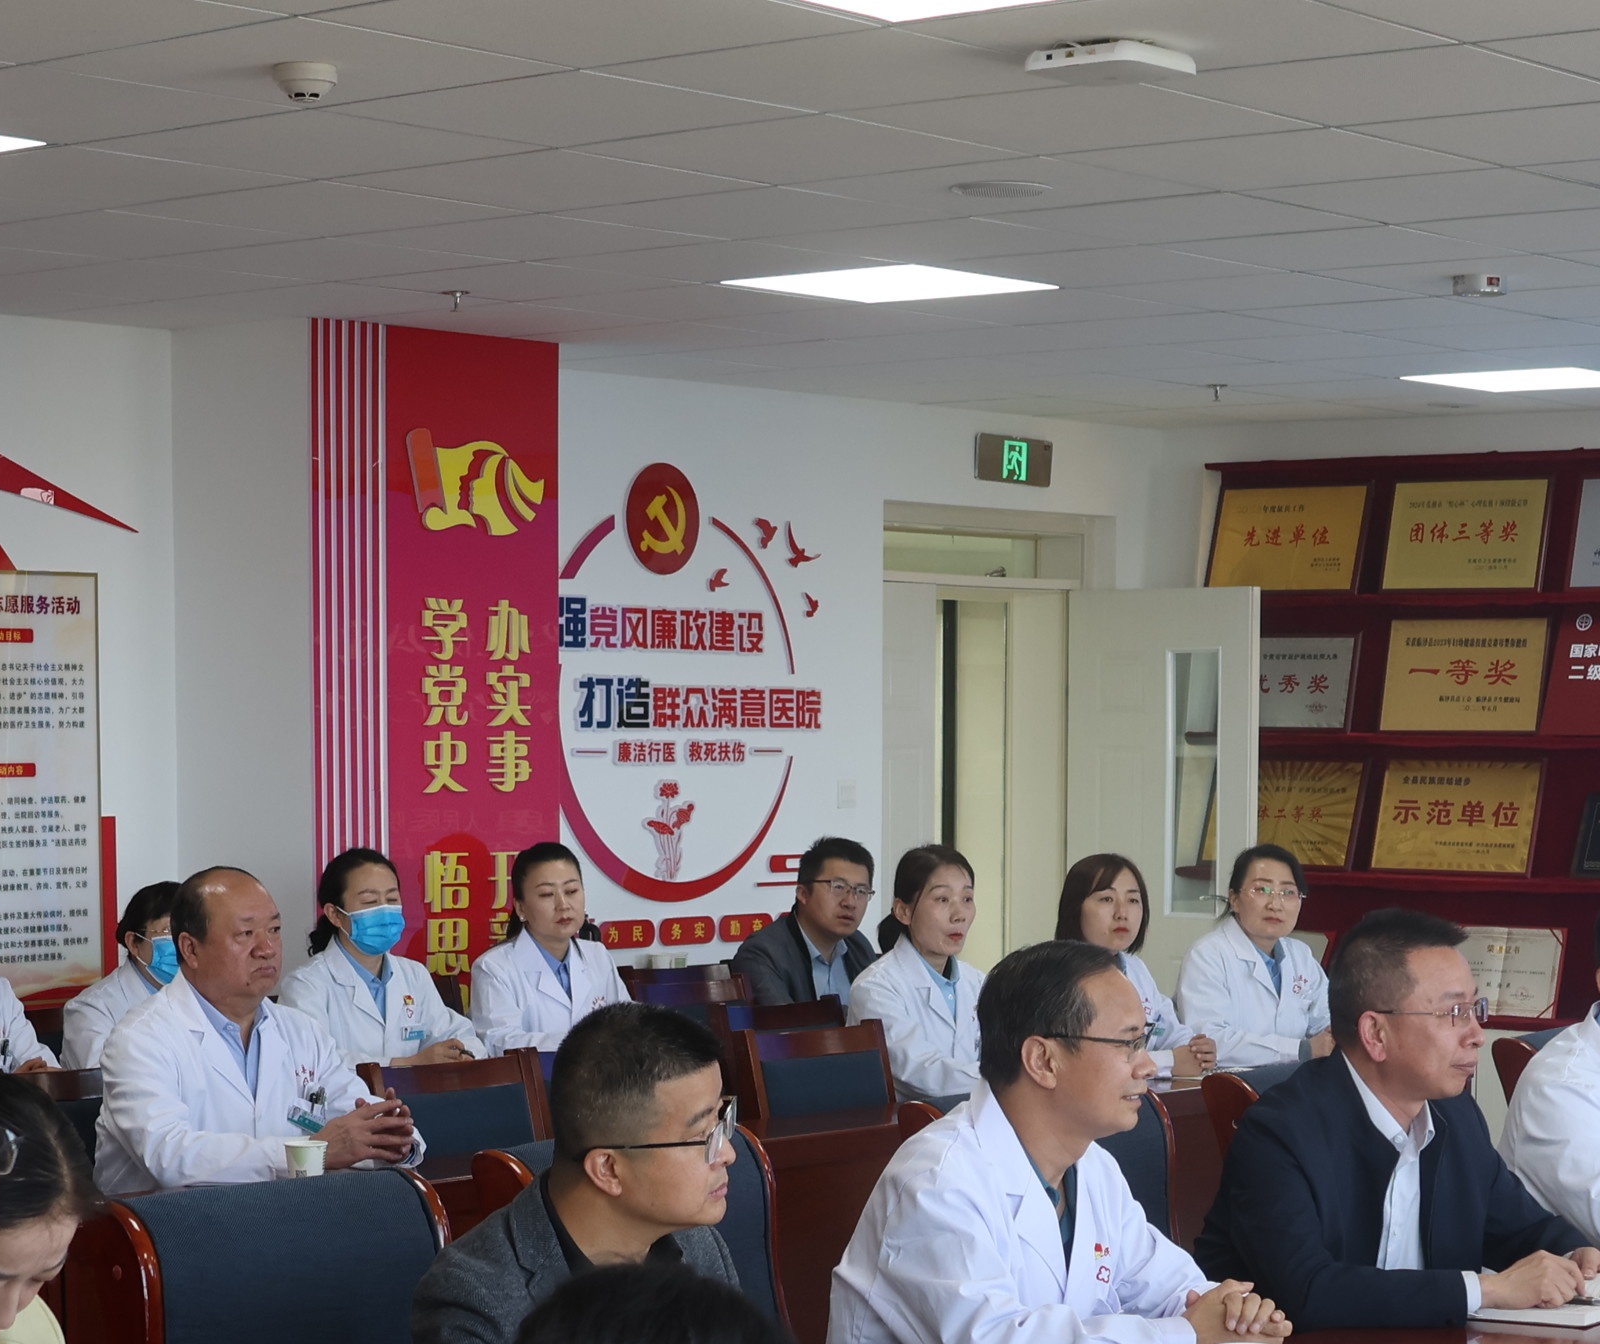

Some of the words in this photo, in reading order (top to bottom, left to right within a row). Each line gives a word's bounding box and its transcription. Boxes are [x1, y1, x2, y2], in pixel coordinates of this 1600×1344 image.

[1242, 523, 1331, 547] 先进单位
[1408, 520, 1519, 544] 团体三等奖
[1408, 658, 1518, 686] 一等奖
[421, 595, 470, 794] 学党史
[485, 598, 533, 794] 办实事
[578, 676, 822, 730] 打造群众满意医院
[617, 741, 676, 763] 廉洁行医
[689, 742, 746, 763] 救死扶伤
[1402, 776, 1471, 786] 全县民族团结进步
[1393, 799, 1520, 827] 示范单位
[424, 850, 471, 1005] 悟思
[608, 926, 644, 944] 为民
[671, 922, 705, 940] 务实
